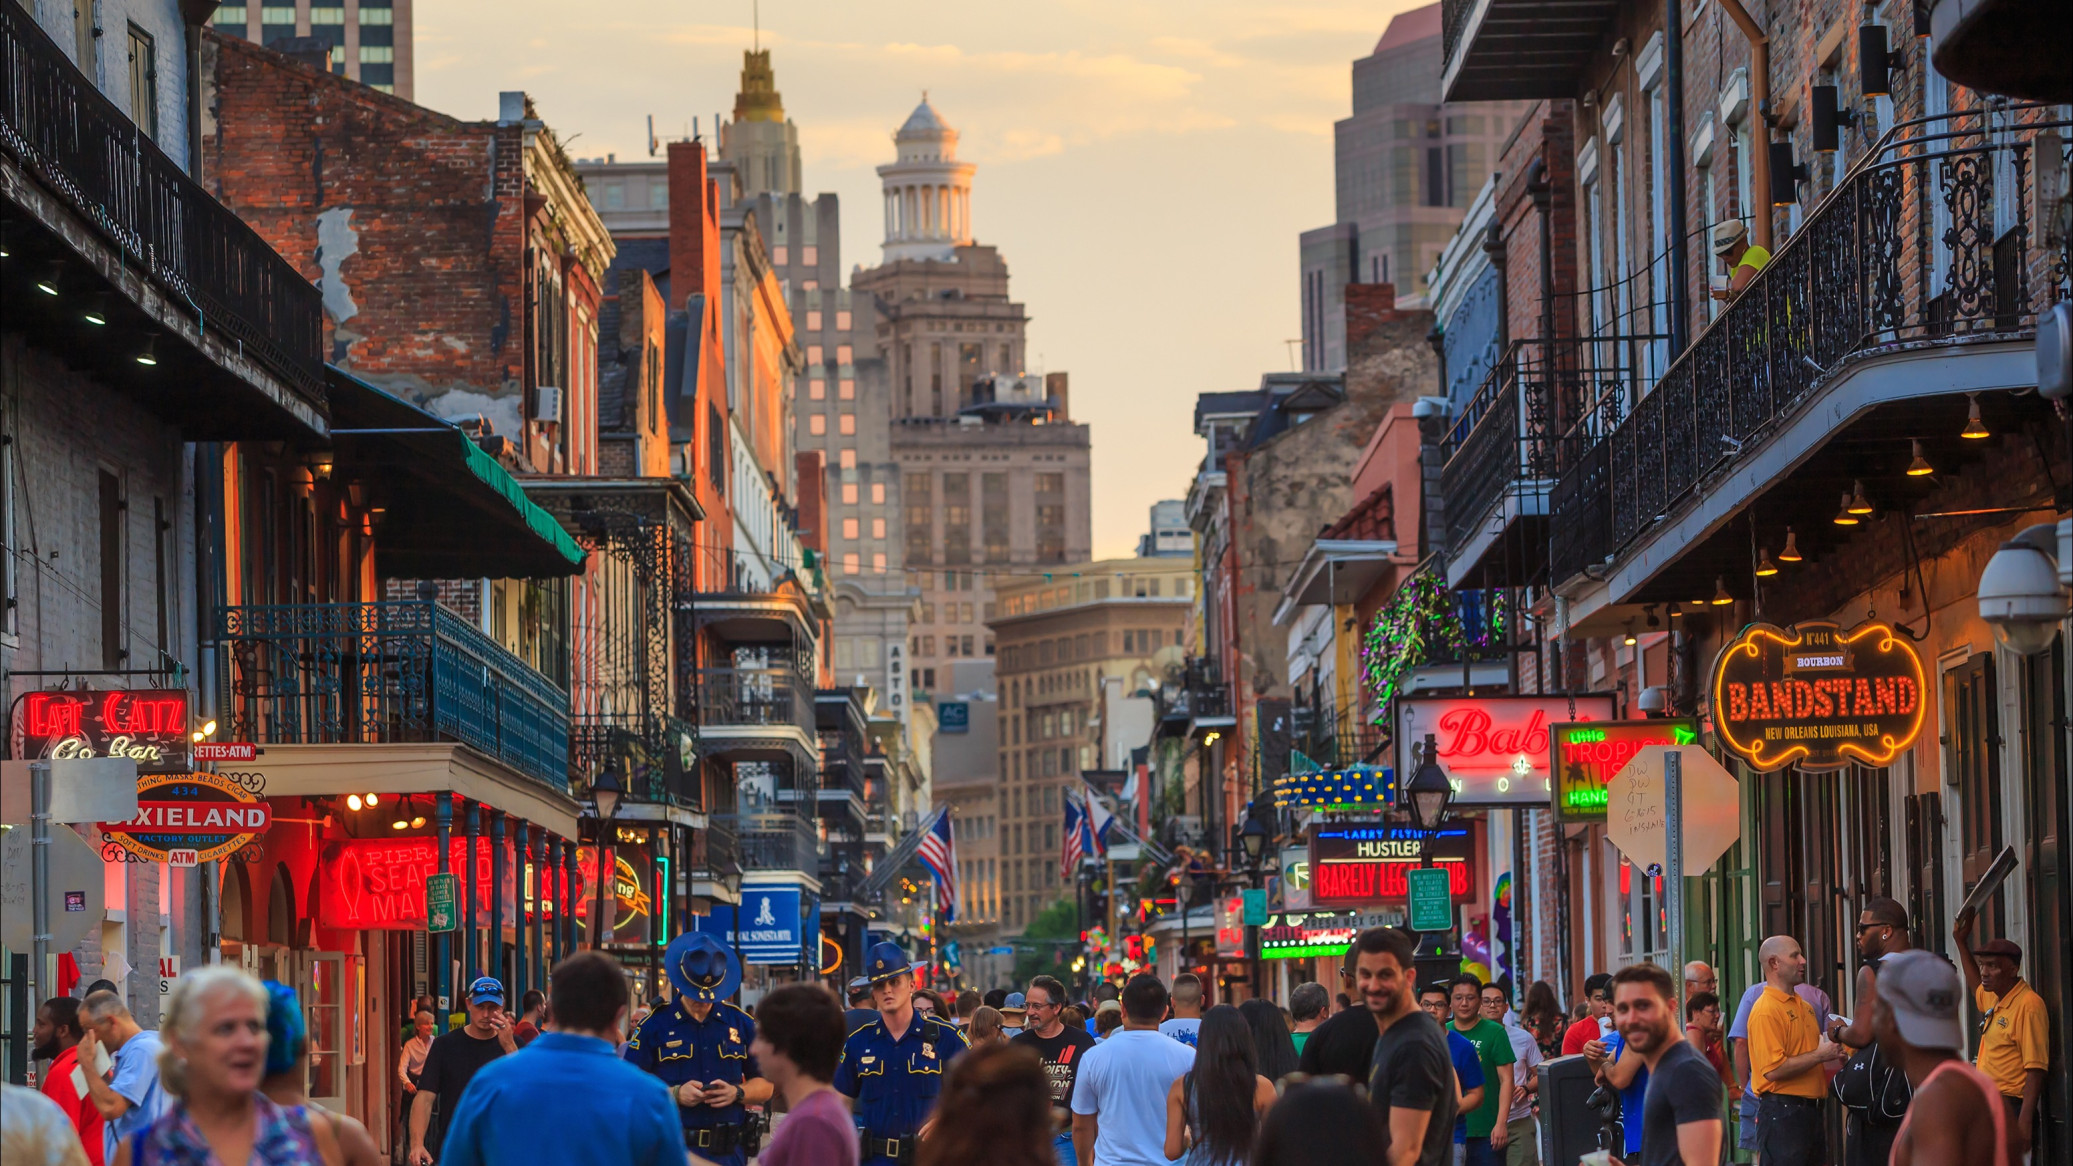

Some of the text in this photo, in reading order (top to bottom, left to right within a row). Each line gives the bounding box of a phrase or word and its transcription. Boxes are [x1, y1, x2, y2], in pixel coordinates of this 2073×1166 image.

[1796, 655, 1844, 668] BOURBON
[1727, 675, 1918, 722] BANDSTAND
[1765, 723, 1879, 740] NEW ORLEANS LOUISIANA, USA
[171, 786, 199, 796] 434
[197, 774, 225, 787] BEADS
[226, 783, 248, 800] CIGAR
[138, 834, 227, 843] FACTORY OUTLET
[1343, 828, 1385, 840] LARRY
[118, 834, 164, 860] SOFT DRINKS
[199, 834, 246, 860] CIGARETTES
[1357, 840, 1421, 857] HUSTLER
[170, 851, 195, 864] ATM
[366, 846, 433, 866] PIER
[1317, 863, 1376, 897] BARELY
[1304, 917, 1339, 930] FRESH
[1369, 913, 1402, 926] GRILL
